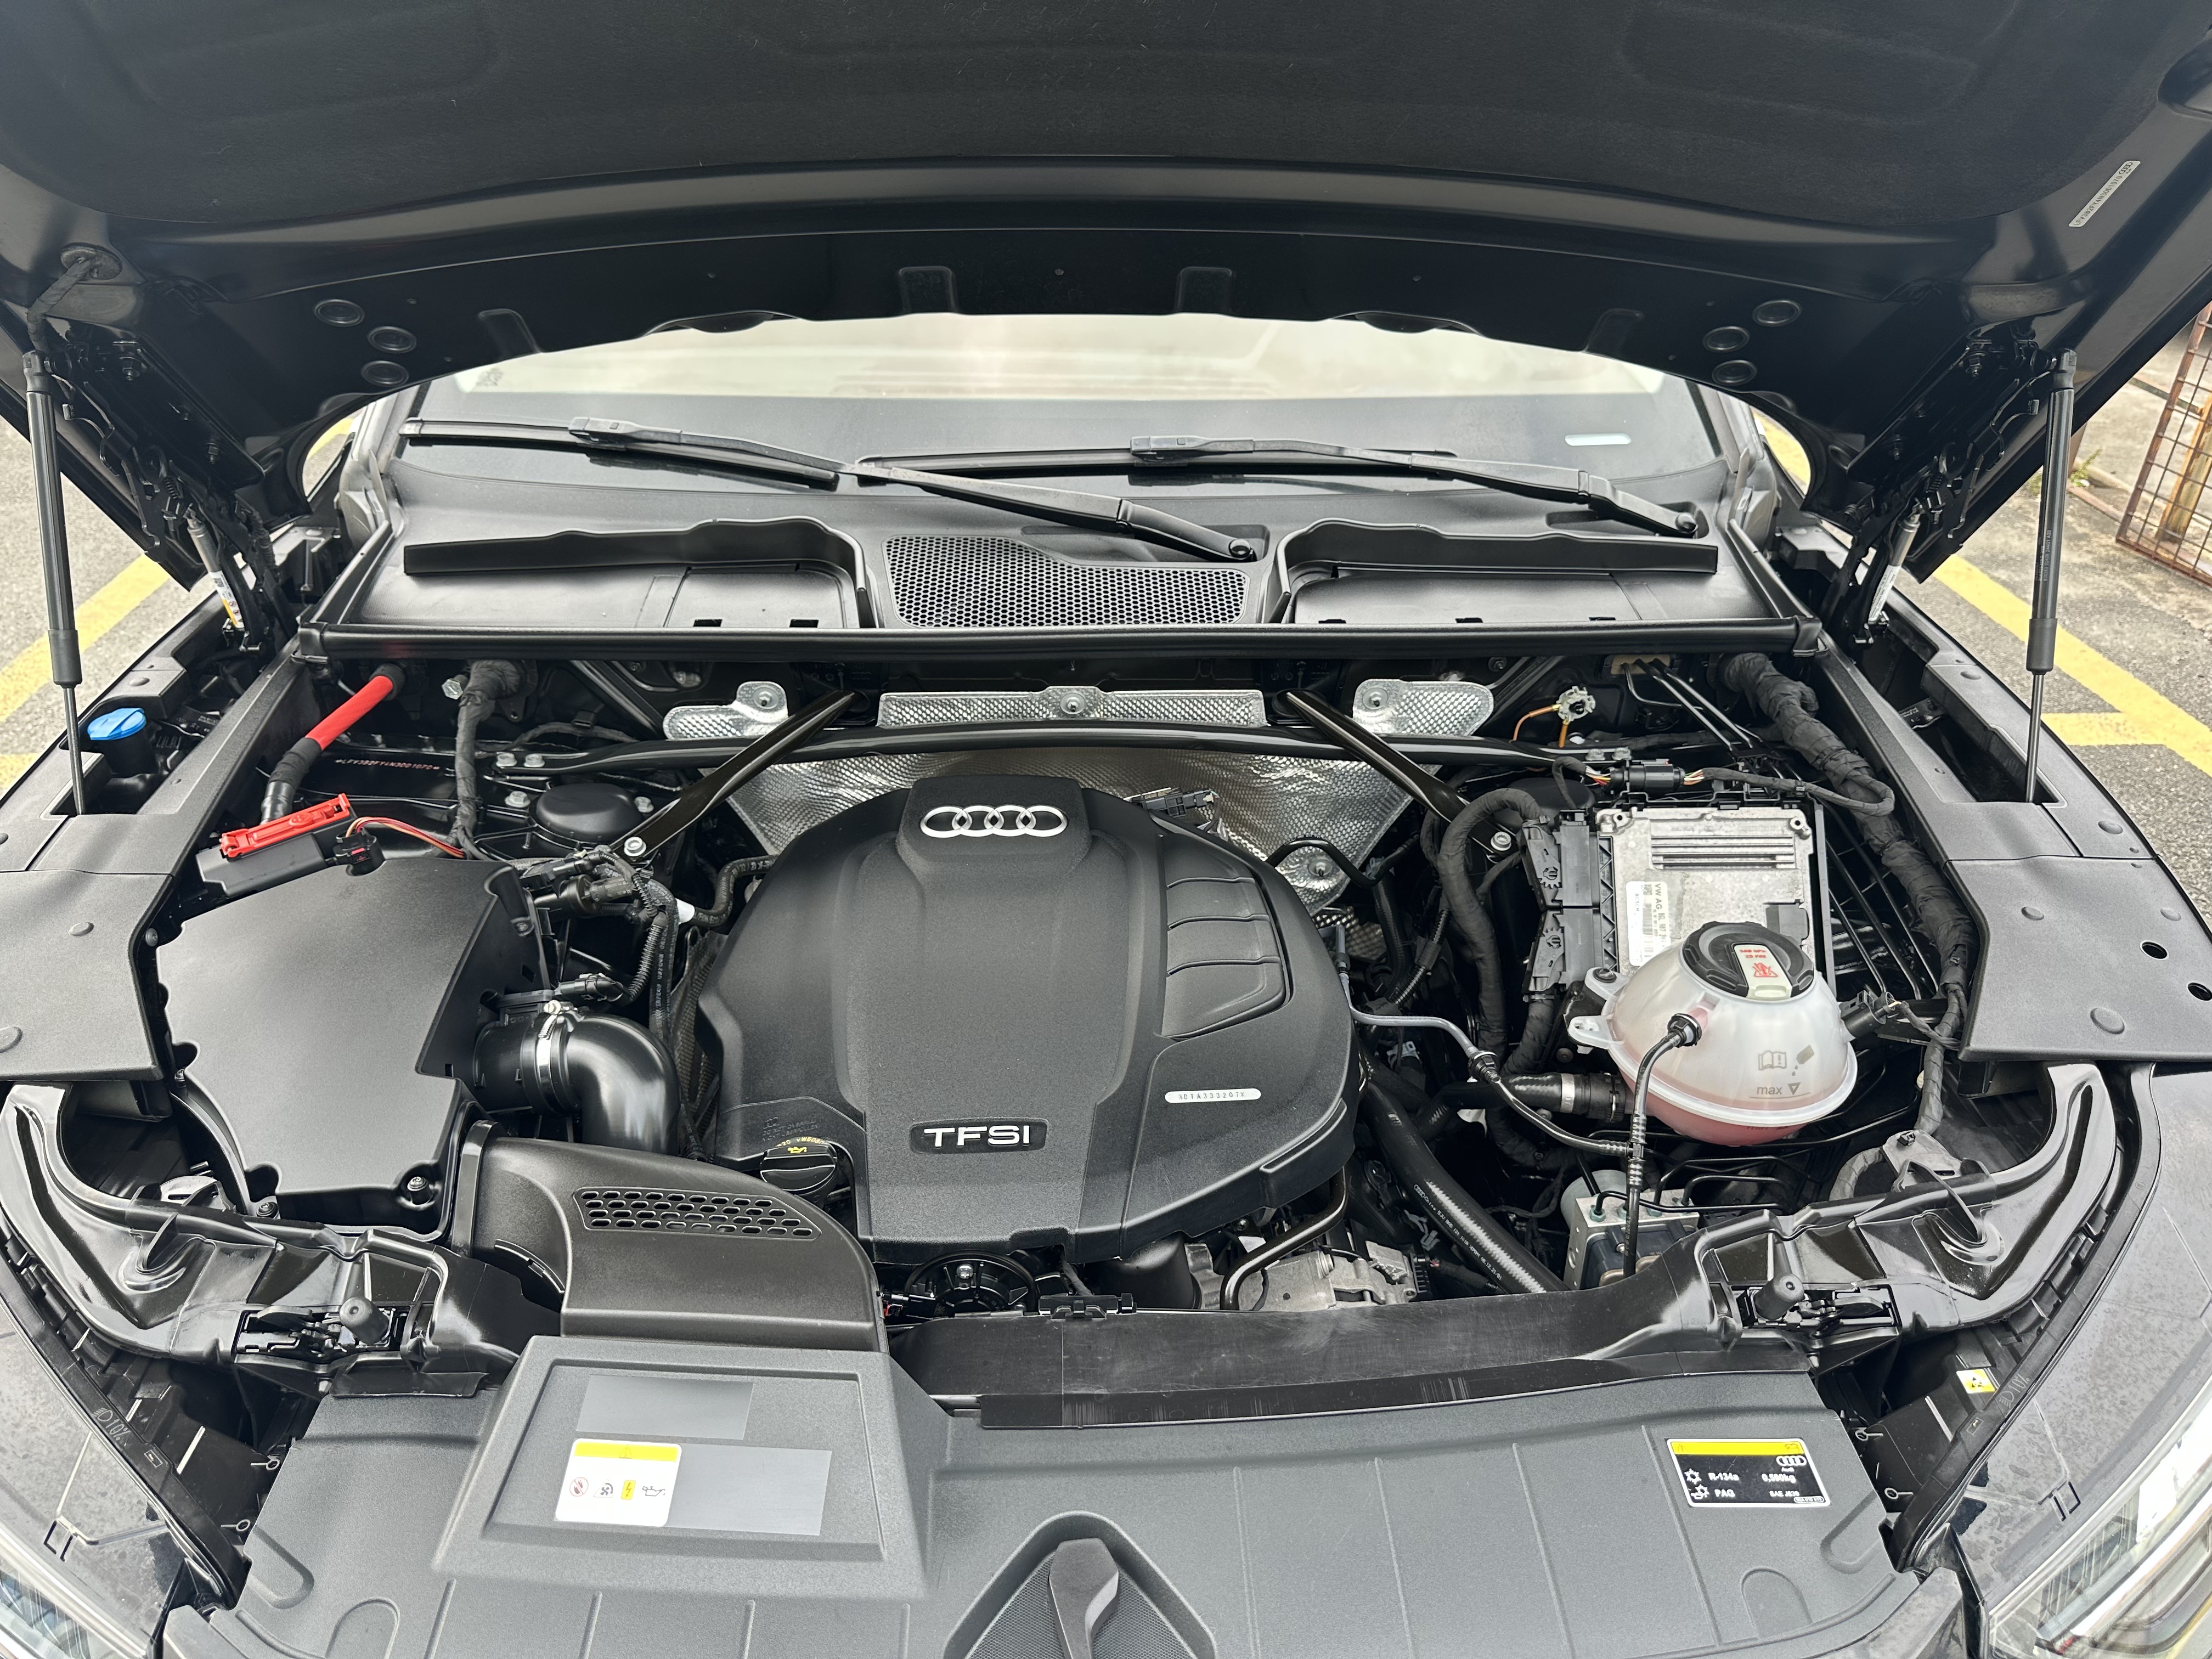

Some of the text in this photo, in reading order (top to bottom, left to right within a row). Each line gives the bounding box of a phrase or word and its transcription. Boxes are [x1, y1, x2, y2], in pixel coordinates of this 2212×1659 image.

[1655, 884, 1662, 896] VW
[1656, 898, 1662, 910] AG
[1757, 1086, 1782, 1095] max
[924, 1125, 1030, 1148] TFSI
[1708, 1472, 1740, 1481] R-134a
[1714, 1489, 1735, 1498] PAG
